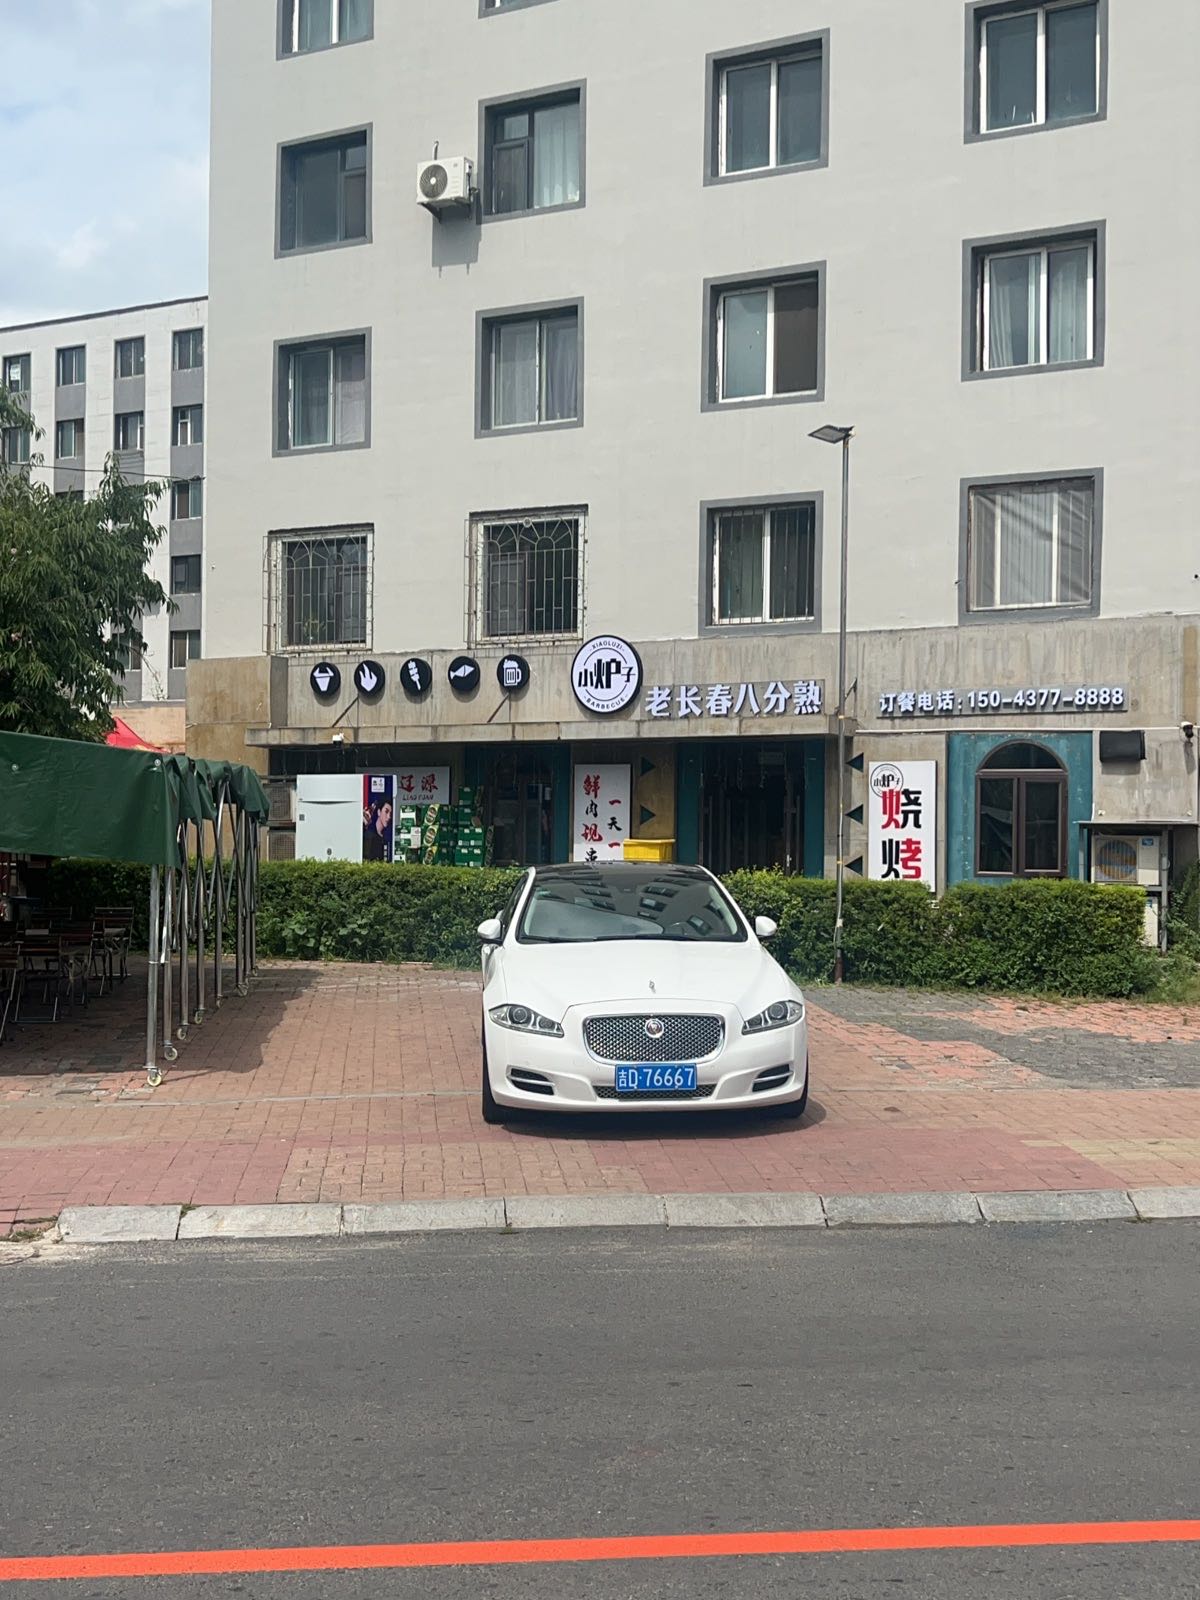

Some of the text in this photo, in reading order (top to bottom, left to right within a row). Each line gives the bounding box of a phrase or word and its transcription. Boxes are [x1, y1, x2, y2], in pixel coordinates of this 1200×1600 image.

[591, 640, 623, 650] XIAOLUZI
[578, 658, 636, 689] 小炉子
[586, 697, 626, 710] BARBECUE
[645, 680, 822, 717] 老长春八分熟
[607, 799, 622, 861] 一天一
[881, 788, 922, 879] 烧烤
